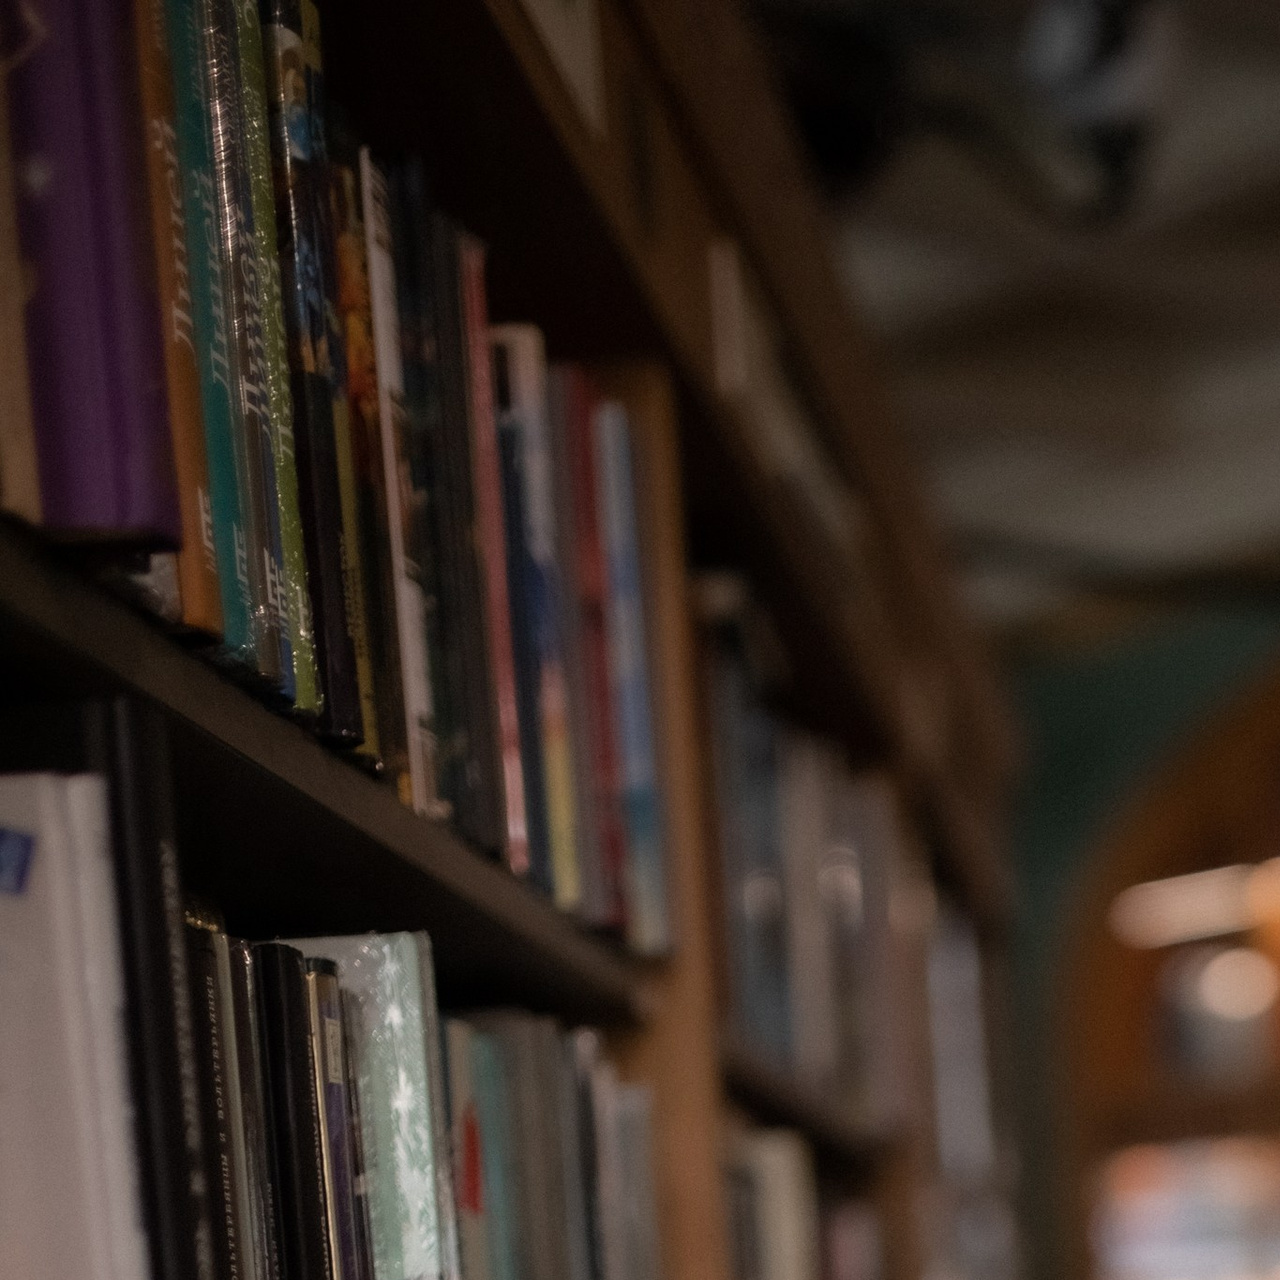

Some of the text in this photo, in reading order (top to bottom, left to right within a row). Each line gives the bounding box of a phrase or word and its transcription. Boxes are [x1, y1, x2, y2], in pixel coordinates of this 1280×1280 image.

[154, 116, 196, 358] Лицей
[193, 169, 232, 398] Лицей
[204, 975, 225, 1120] ВОЛЬТЕРЬЯНКИ
